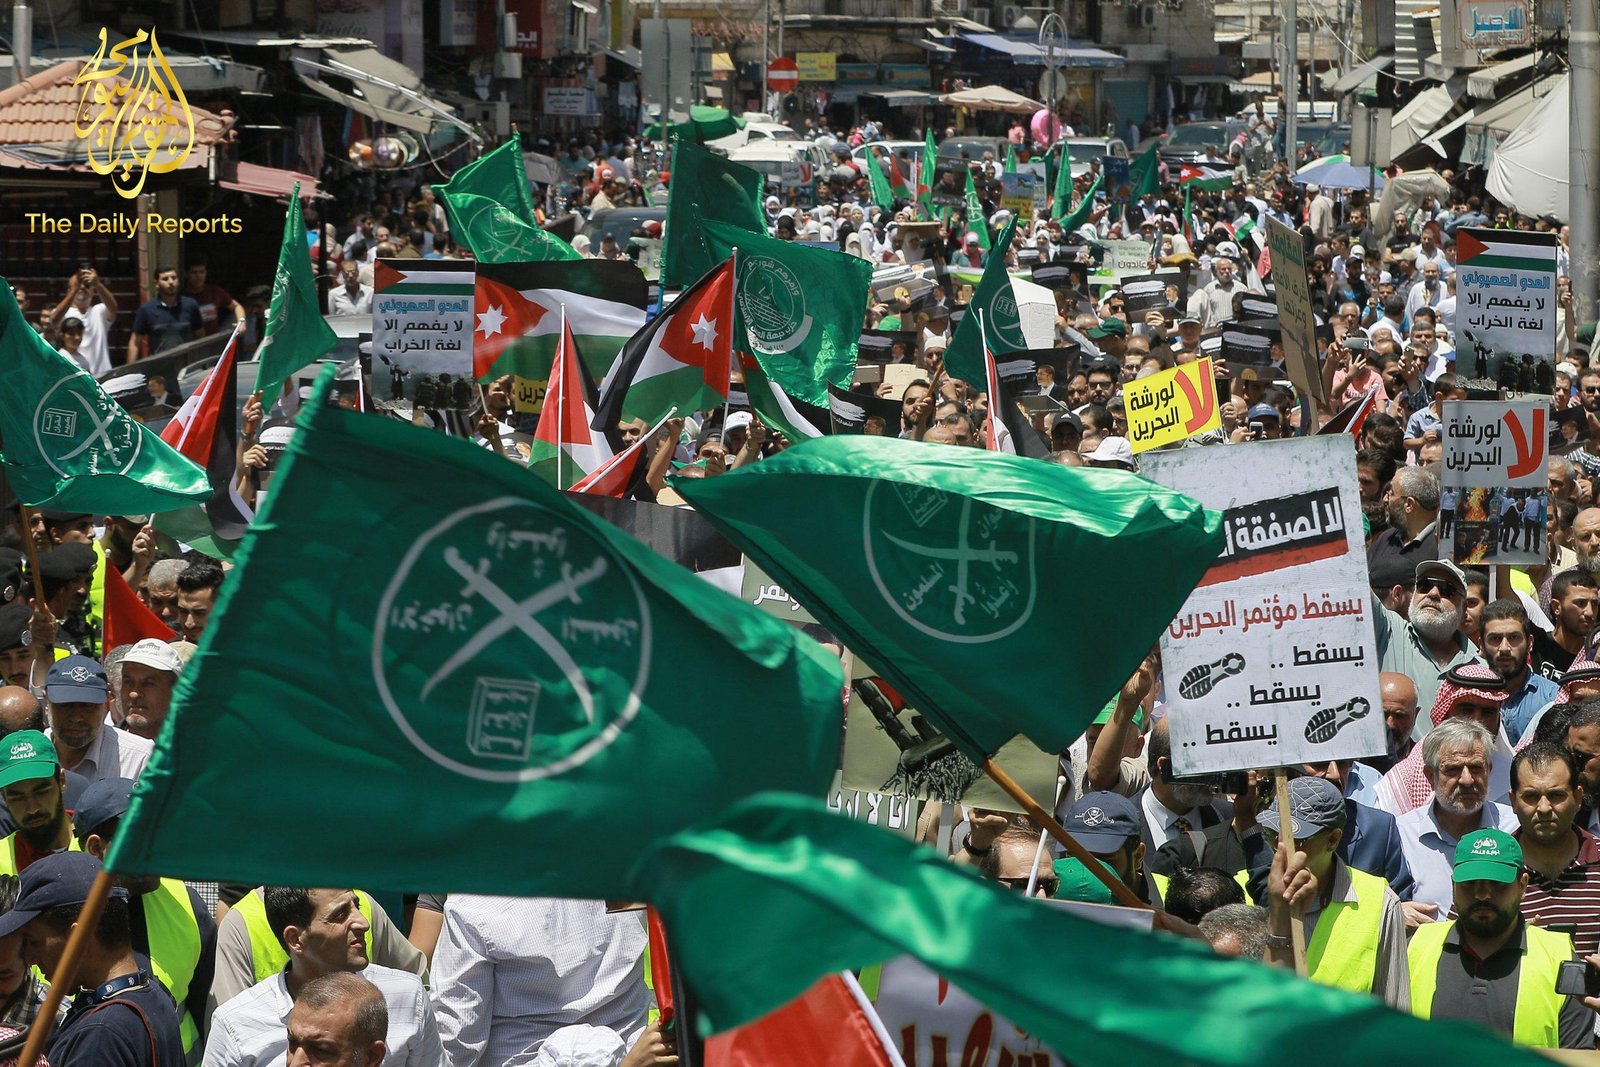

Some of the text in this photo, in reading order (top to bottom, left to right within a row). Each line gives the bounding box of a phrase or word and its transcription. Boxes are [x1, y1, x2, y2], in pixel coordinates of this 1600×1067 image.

[1462, 271, 1550, 292] العدو الصهيوني
[379, 299, 469, 315] العدو الصهيوني
[1467, 292, 1545, 312] لا يفهم إلا
[384, 319, 463, 334] لا يفهم إلا
[1468, 314, 1543, 330] لغة الخراب
[384, 339, 461, 353] لغة الخراب
[519, 382, 546, 405] حرين
[1130, 360, 1214, 434] لا لورشة
[1133, 406, 1180, 441] البحرين
[1448, 409, 1545, 479] لا لورشة
[1446, 446, 1502, 472] البحرين
[1235, 500, 1322, 550] لصفقة
[1322, 496, 1343, 533] لا
[1168, 593, 1364, 639] يسقط مؤتمر البحرين
[1293, 643, 1365, 667] يسقط
[1249, 682, 1322, 706] يسقط
[1205, 721, 1278, 746] يسقط
